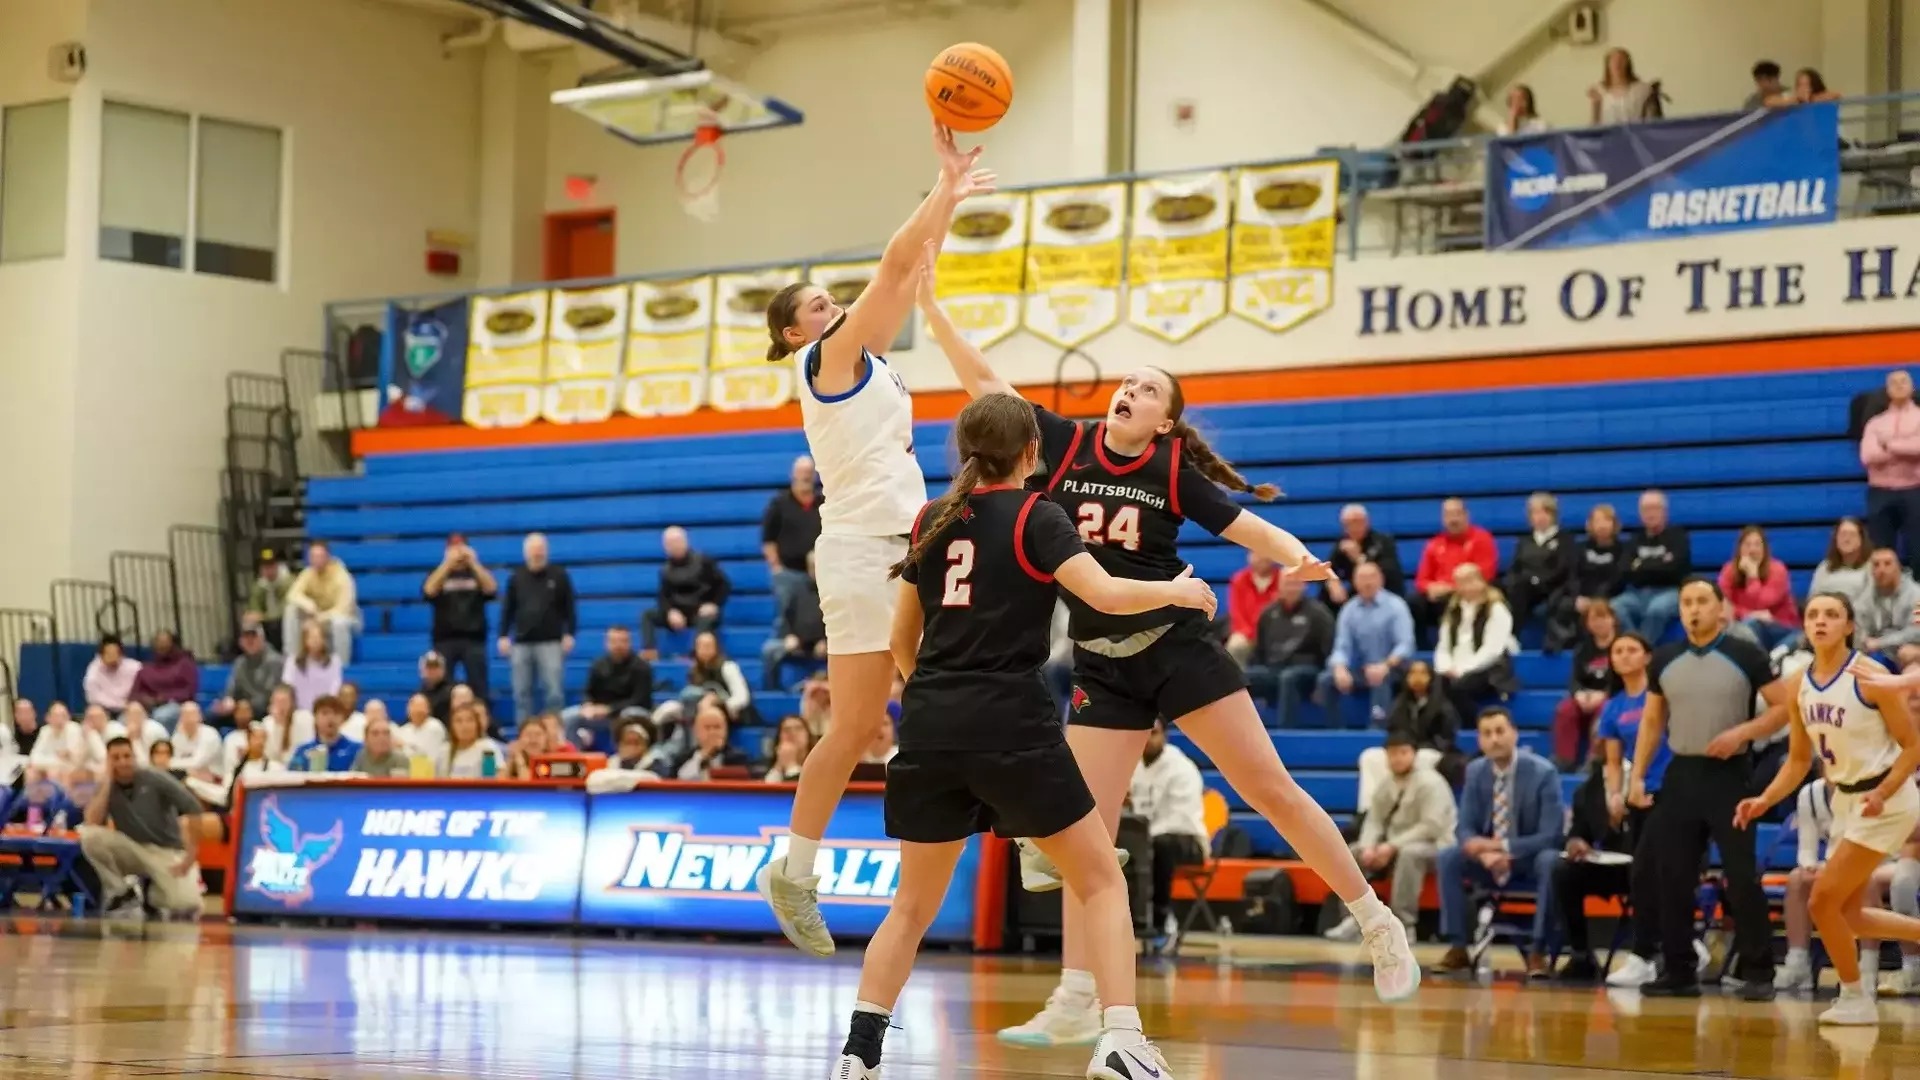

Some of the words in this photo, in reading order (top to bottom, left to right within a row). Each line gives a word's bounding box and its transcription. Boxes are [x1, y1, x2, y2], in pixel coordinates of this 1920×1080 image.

[1648, 178, 1826, 229] BASKETBALL
[1358, 284, 1527, 336] HOME
[1559, 269, 1645, 322] OF
[1676, 258, 1805, 314] THE
[1063, 479, 1166, 511] PLATTSBURGH
[1077, 501, 1142, 552] 24
[942, 538, 975, 607] 2
[362, 808, 446, 837] HOME
[446, 810, 488, 838] OF
[347, 847, 547, 901] HAWKS
